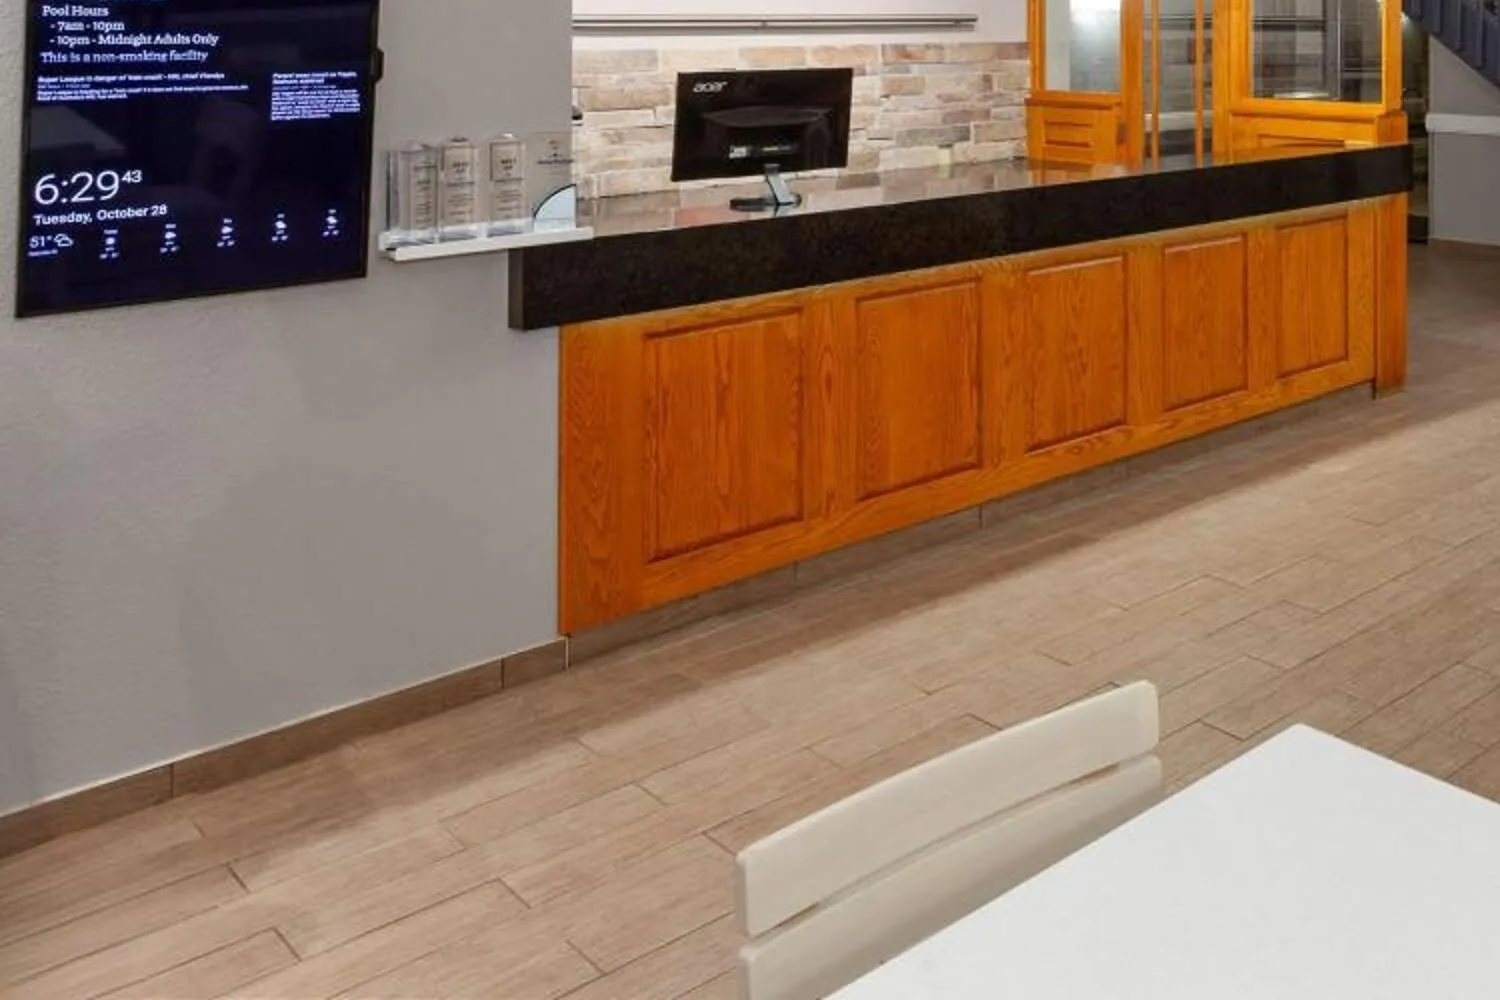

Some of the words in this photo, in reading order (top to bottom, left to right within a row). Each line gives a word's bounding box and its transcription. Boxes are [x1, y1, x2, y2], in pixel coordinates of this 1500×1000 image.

[42, 5, 69, 16] Pool
[71, 5, 109, 17] Hours
[57, 21, 84, 32] 7am
[93, 21, 125, 32] 10pm
[57, 35, 90, 47] 10pm
[98, 33, 152, 46] Midnight
[154, 33, 191, 45] Adults
[192, 33, 219, 46] Only
[40, 51, 67, 63] This
[69, 51, 81, 63] is
[83, 53, 91, 63] a
[93, 50, 168, 63] non-smoking
[169, 49, 209, 63] facility
[693, 81, 729, 94] acer
[35, 170, 119, 205] 6:29
[121, 169, 143, 183] 43
[33, 211, 92, 226] Tuesday,
[96, 207, 149, 220] October
[151, 204, 168, 215] 28
